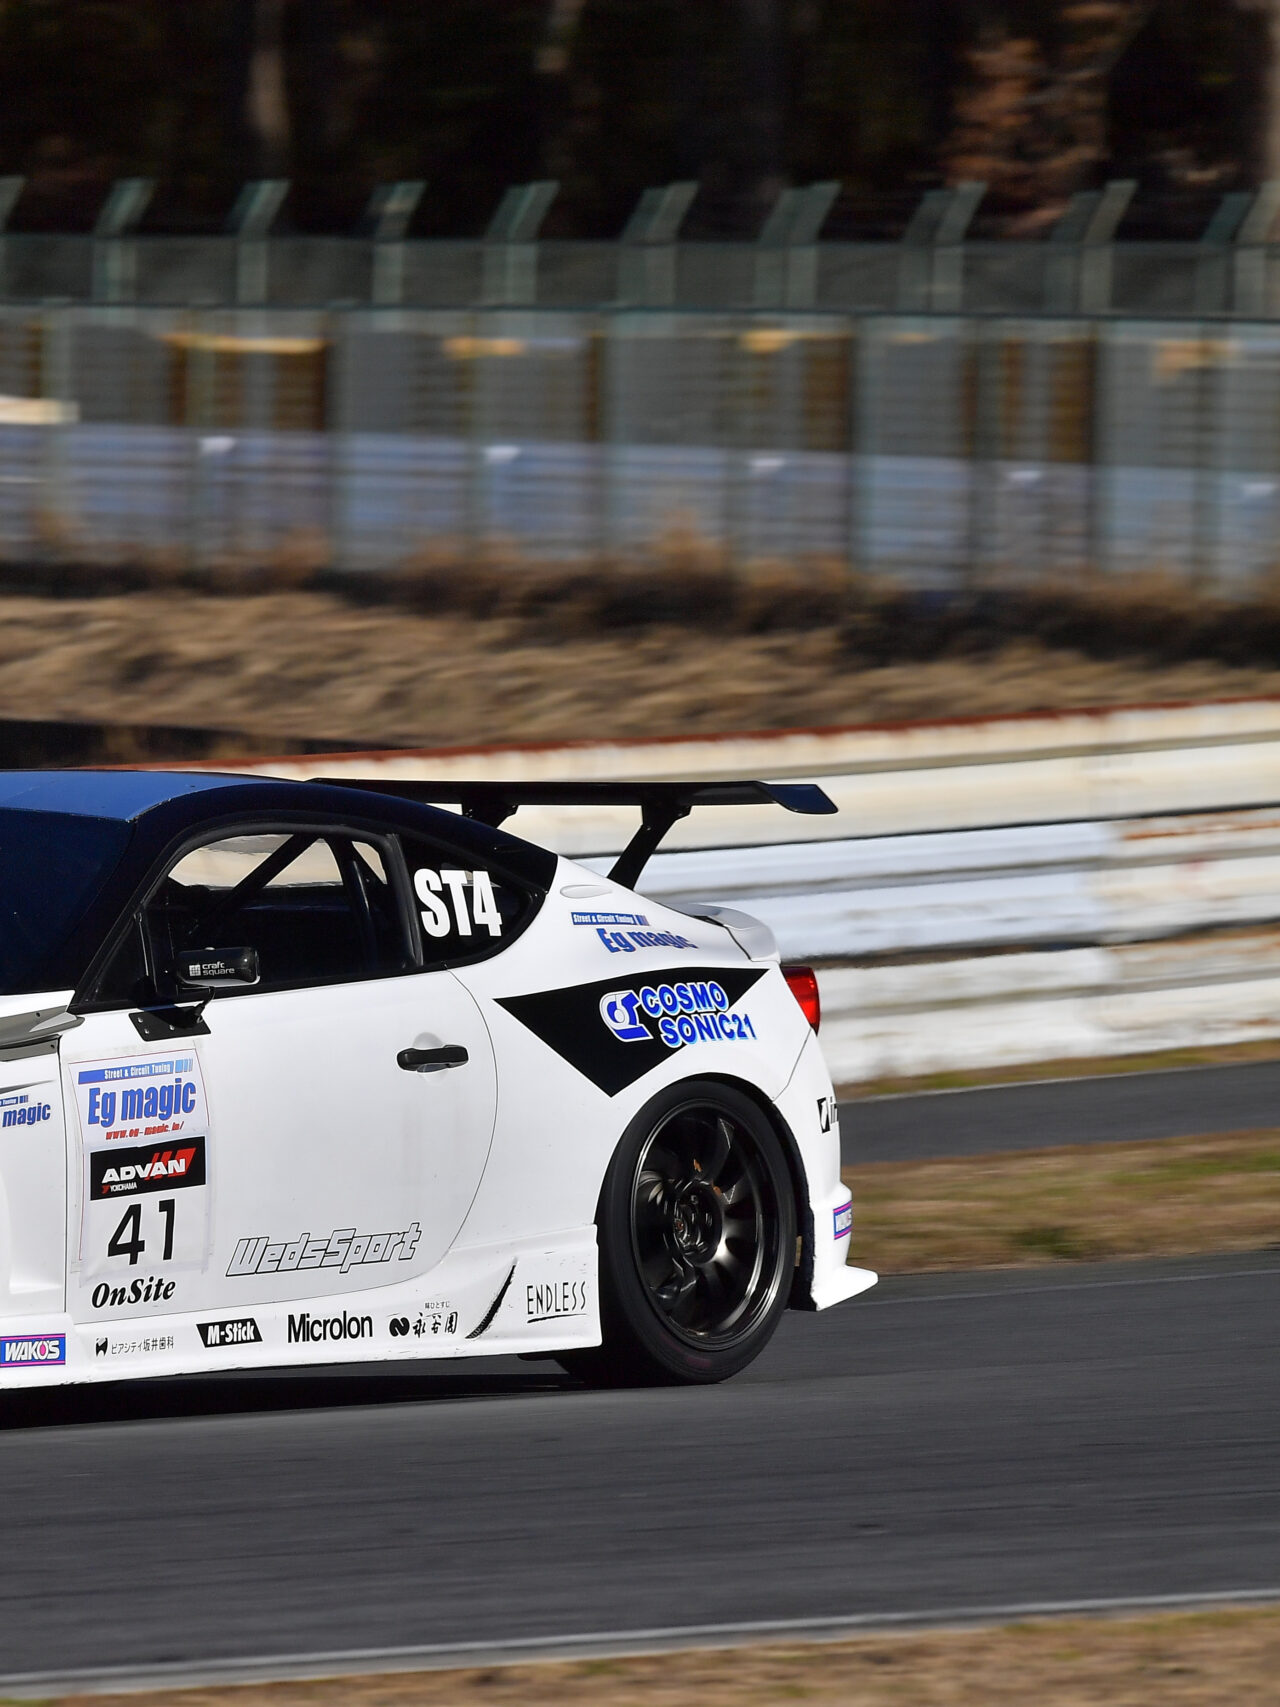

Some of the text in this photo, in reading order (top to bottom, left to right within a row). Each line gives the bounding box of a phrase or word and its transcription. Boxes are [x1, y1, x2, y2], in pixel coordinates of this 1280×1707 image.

[414, 869, 502, 937] ST4
[596, 928, 636, 953] Eg
[202, 961, 225, 969] craft
[202, 967, 235, 976] square
[639, 981, 729, 1018] COSMO
[658, 1012, 757, 1049] SONIC21
[104, 1069, 123, 1080] Street
[130, 1066, 150, 1077] Circuit
[152, 1063, 171, 1075] Tuning
[2, 1102, 51, 1128] magic
[88, 1078, 196, 1128] Eg magic
[102, 1158, 186, 1184] ADVAN
[109, 1182, 138, 1193] YOKOHAMA
[107, 1199, 175, 1265] 41
[225, 1223, 422, 1276] WedsSport
[92, 1276, 176, 1308] OnSite
[526, 1281, 587, 1315] ENDLESS
[207, 1321, 256, 1345] M-Stick
[287, 1311, 373, 1343] Microlon
